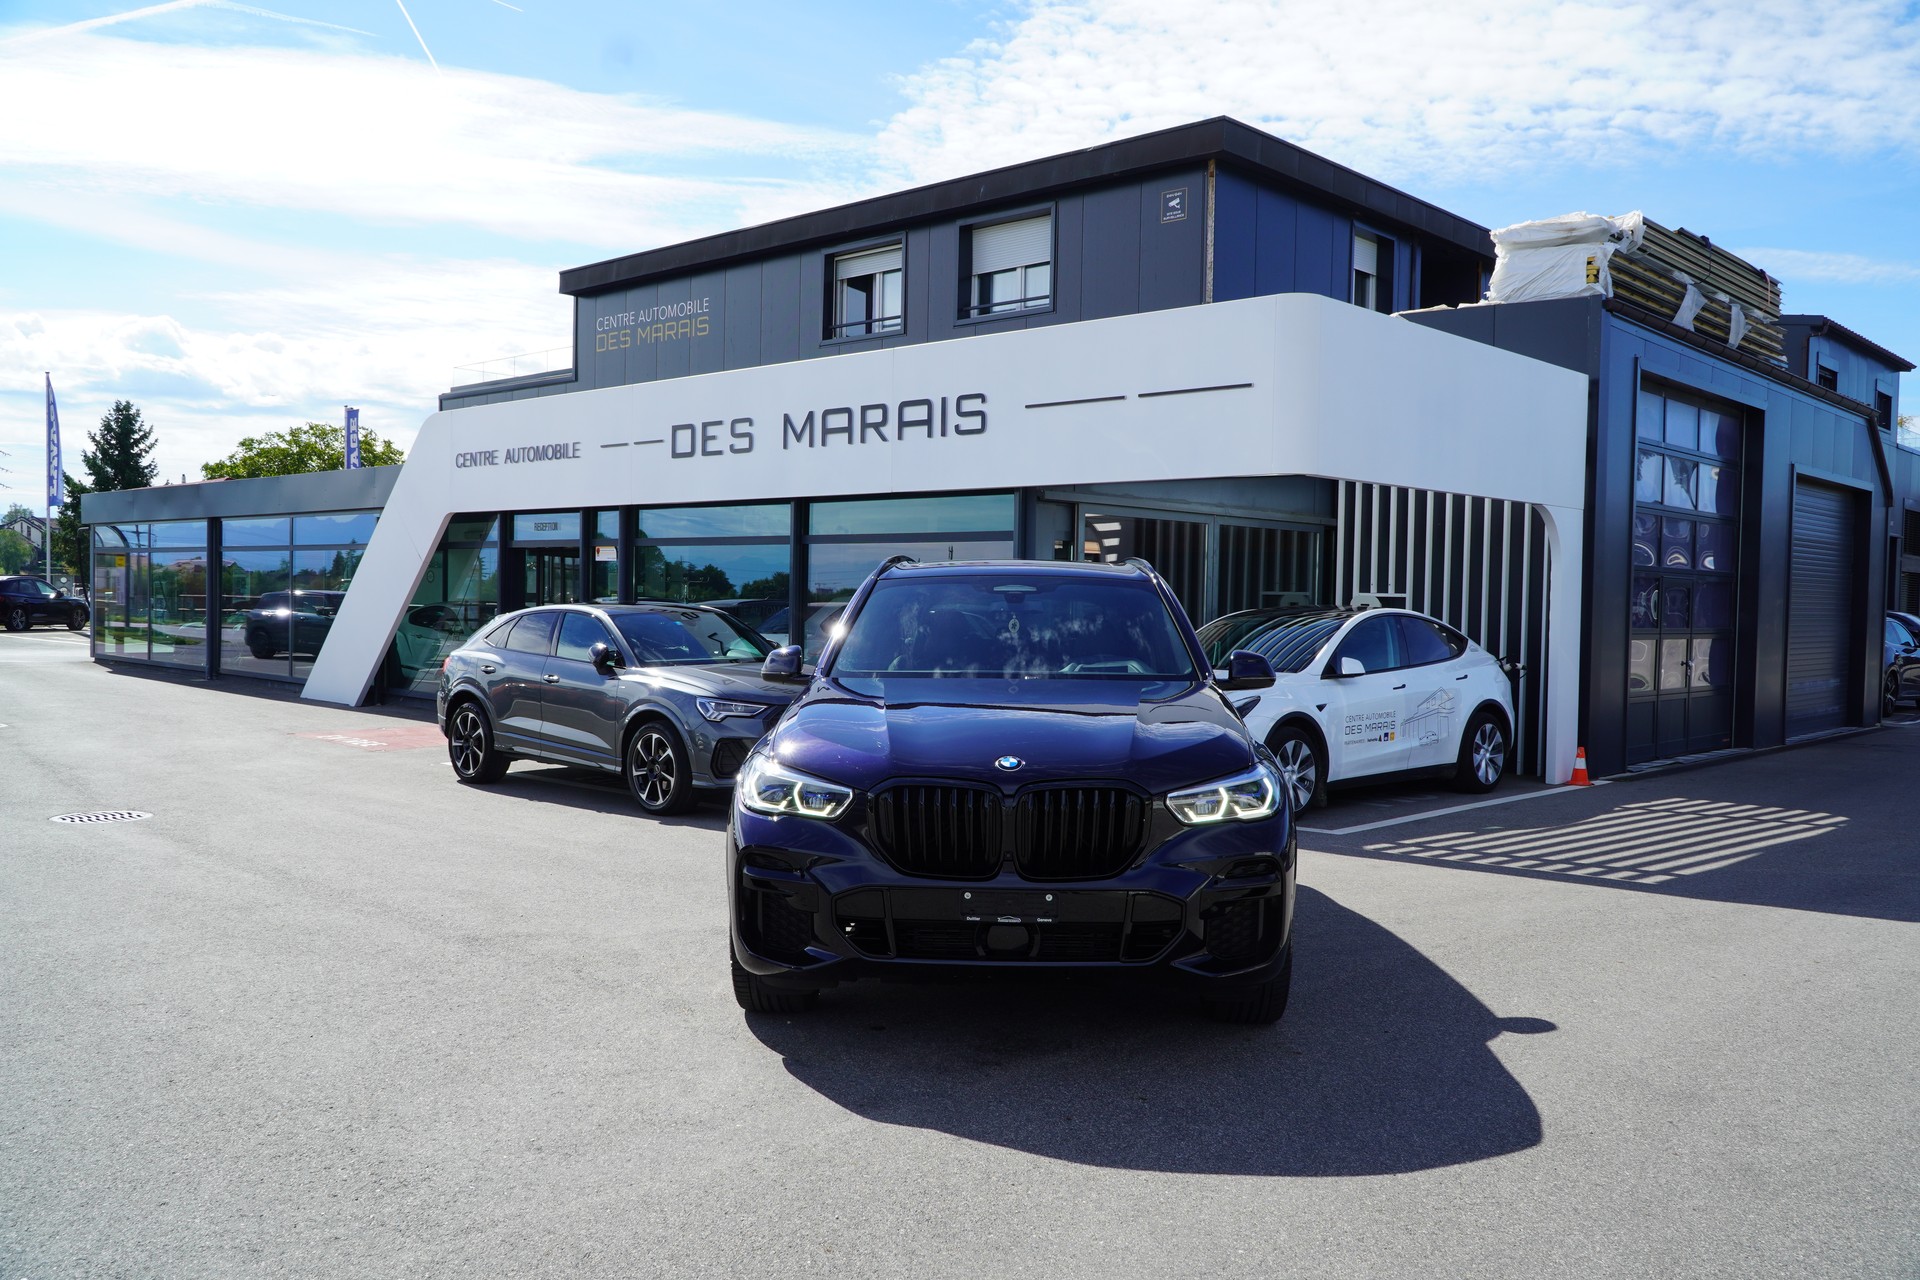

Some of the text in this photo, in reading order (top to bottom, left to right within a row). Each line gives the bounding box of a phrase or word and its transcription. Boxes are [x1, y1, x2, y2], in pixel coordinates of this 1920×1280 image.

[597, 297, 710, 331] CENTRE AUTOMOBILE
[596, 316, 709, 353] DES MARAIS
[455, 393, 989, 469] CENTRE AUTOMOBILE DES MARAIS
[1345, 711, 1396, 723] CENTRE AUTOMOBILE
[1345, 721, 1396, 735] DES MARAIS
